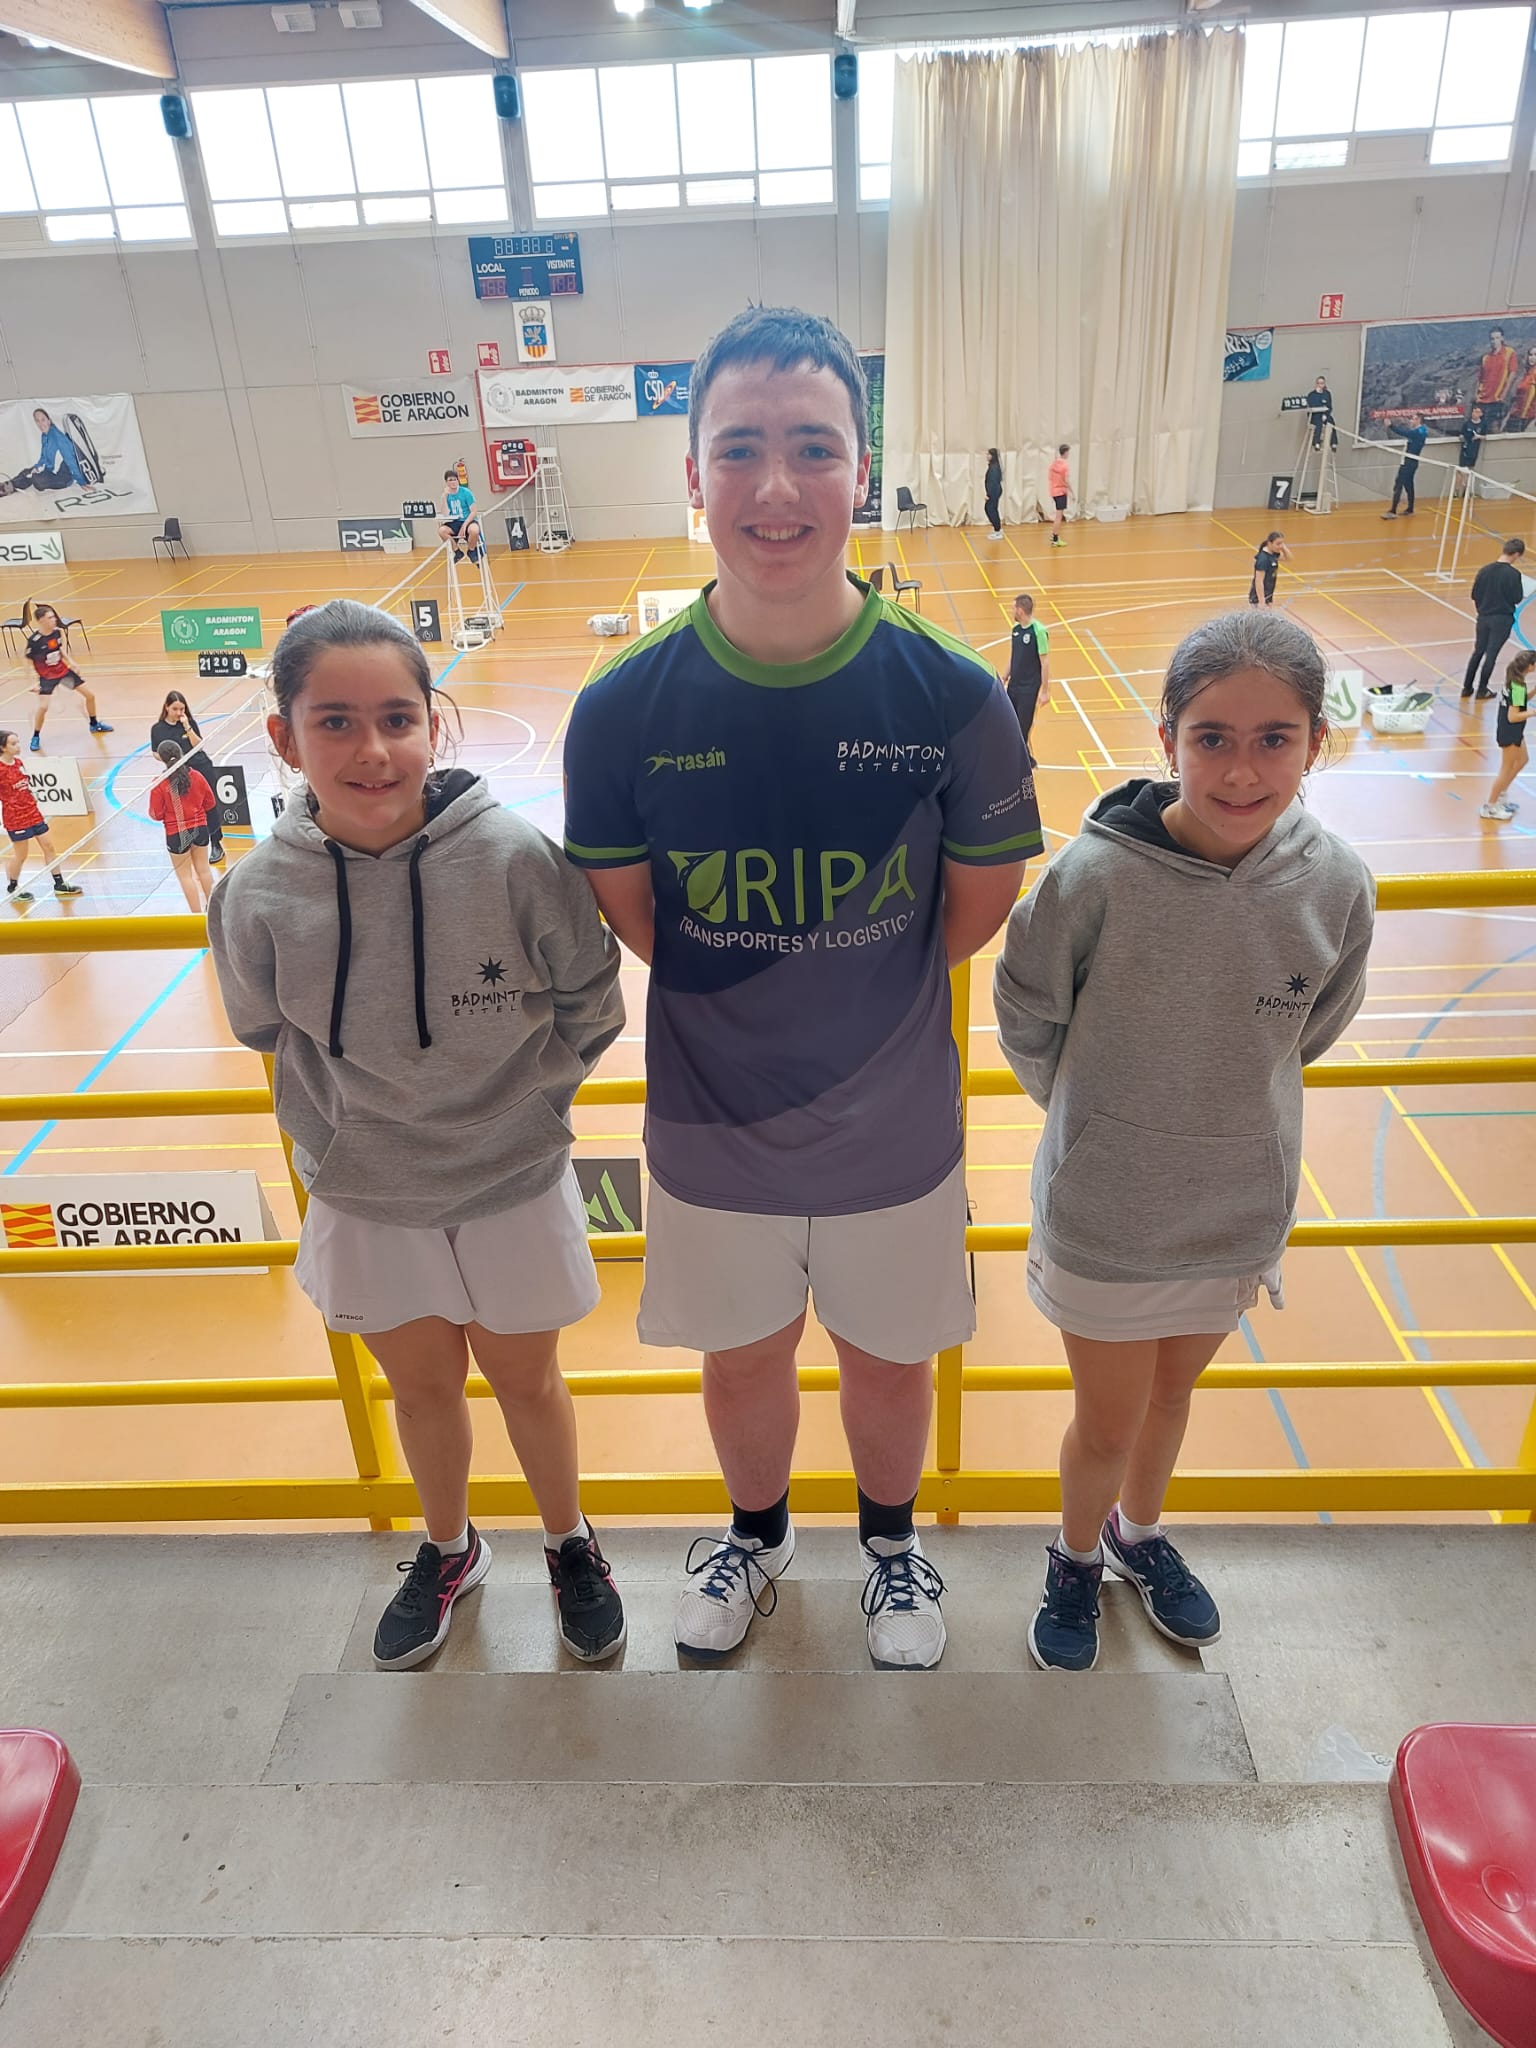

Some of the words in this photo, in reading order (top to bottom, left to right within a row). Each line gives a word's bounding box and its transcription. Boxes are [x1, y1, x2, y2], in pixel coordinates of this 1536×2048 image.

[476, 263, 505, 274] LOCAL
[546, 259, 575, 270] VISITANTE
[515, 387, 564, 397] BADMINTON
[584, 384, 625, 394] GOBIERNO
[584, 394, 596, 403] DE
[598, 392, 631, 402] ARAGON
[645, 380, 664, 401] CSD
[380, 390, 455, 408] GOBIERNO
[523, 397, 557, 406] ARAGON
[382, 409, 402, 423] DE
[407, 404, 470, 422] ARAGON
[1276, 480, 1290, 498] 7
[55, 488, 134, 512] RSL
[511, 521, 523, 538] 4
[0, 544, 42, 561] RSL
[205, 615, 254, 625] BADMINTON
[418, 606, 433, 628] 5
[213, 627, 247, 636] ARAGON
[200, 657, 211, 671] 21
[232, 657, 241, 671] 6
[676, 746, 726, 771] rasán
[837, 739, 945, 761] BÁDMINTON
[838, 761, 942, 773] ESTELLA
[216, 774, 238, 805] 6
[735, 843, 917, 926] RIPA
[679, 914, 804, 953] TRANSPORTES
[807, 932, 820, 950] Y
[56, 1200, 216, 1227] GOBIERNO
[60, 1229, 100, 1247] DE
[335, 1313, 364, 1321] ARTENGO
